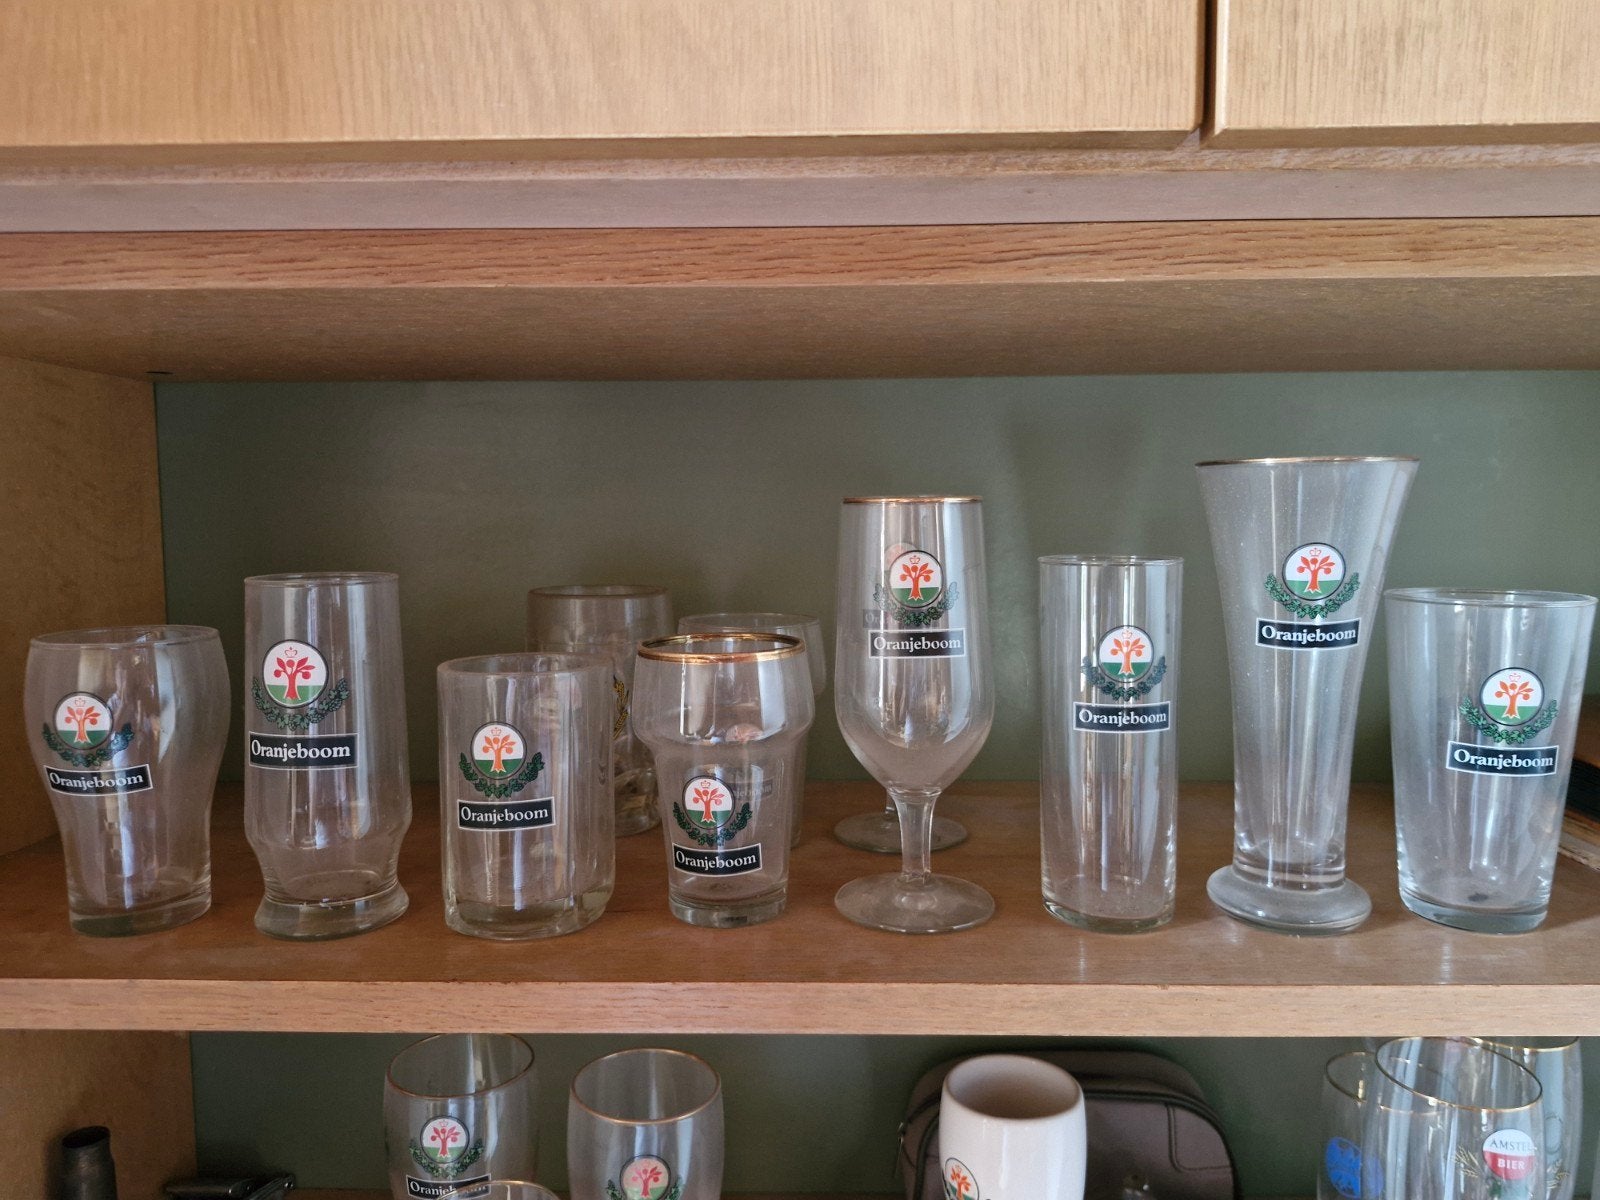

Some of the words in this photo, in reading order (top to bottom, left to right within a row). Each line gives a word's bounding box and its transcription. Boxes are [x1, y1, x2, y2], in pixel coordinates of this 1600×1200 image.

[1261, 624, 1356, 644] Oranjeboom
[873, 635, 961, 652] Oranjeboom
[1079, 709, 1166, 726] Oranjeboom
[252, 740, 350, 760] Oranjeboom
[1453, 748, 1553, 768] Oranjeboom
[50, 771, 142, 789] Oranjeboom
[460, 806, 549, 823] Oranjeboom
[676, 850, 757, 869] Oranjeboom
[1497, 1158, 1525, 1170] BIER
